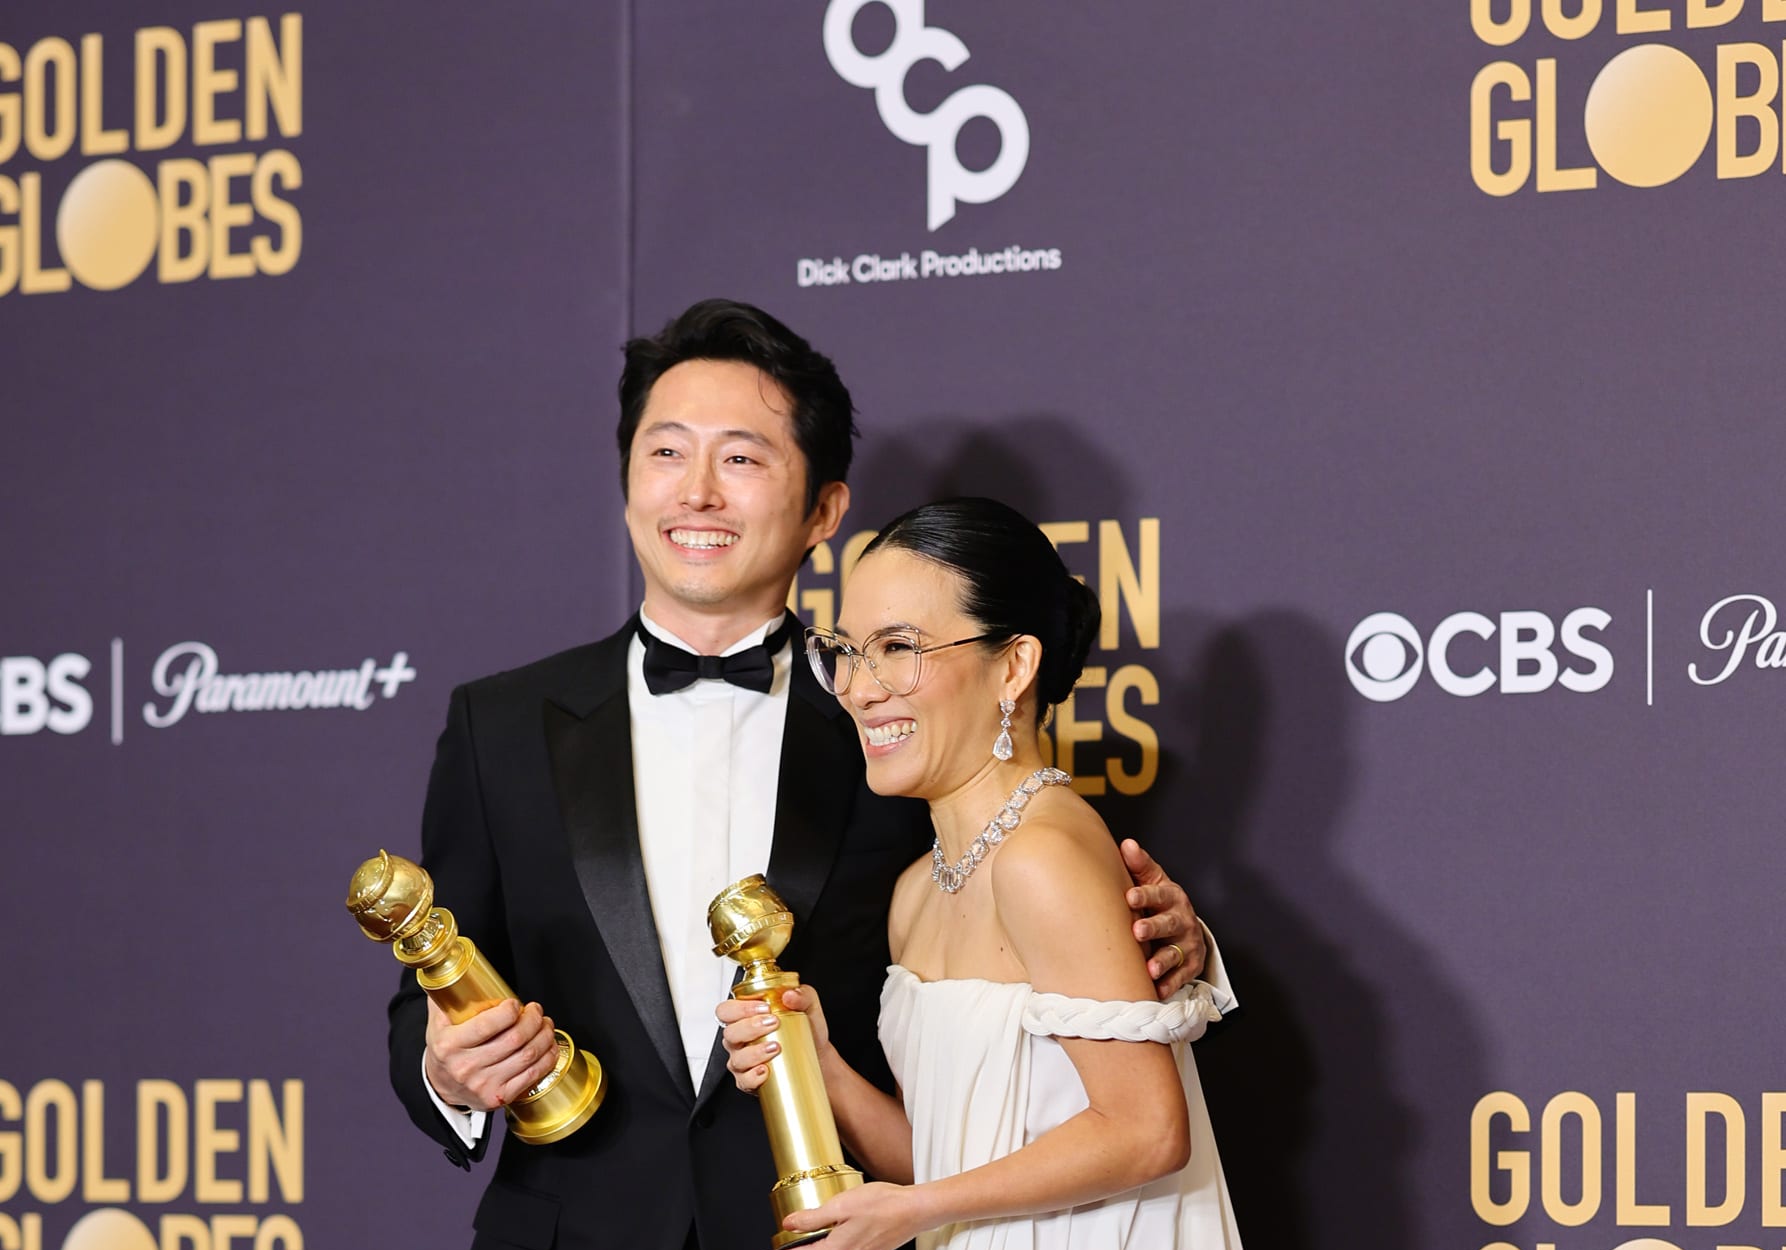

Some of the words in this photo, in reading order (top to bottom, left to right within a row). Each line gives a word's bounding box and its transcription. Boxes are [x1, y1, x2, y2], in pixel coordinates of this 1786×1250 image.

[1470, 40, 1786, 197] GLOB
[797, 258, 850, 287] Dick
[851, 253, 918, 283] Clark
[920, 245, 1062, 278] Productions
[143, 641, 416, 728] Paramount+
[1427, 607, 1614, 697] CBS
[1687, 594, 1786, 686] Pa
